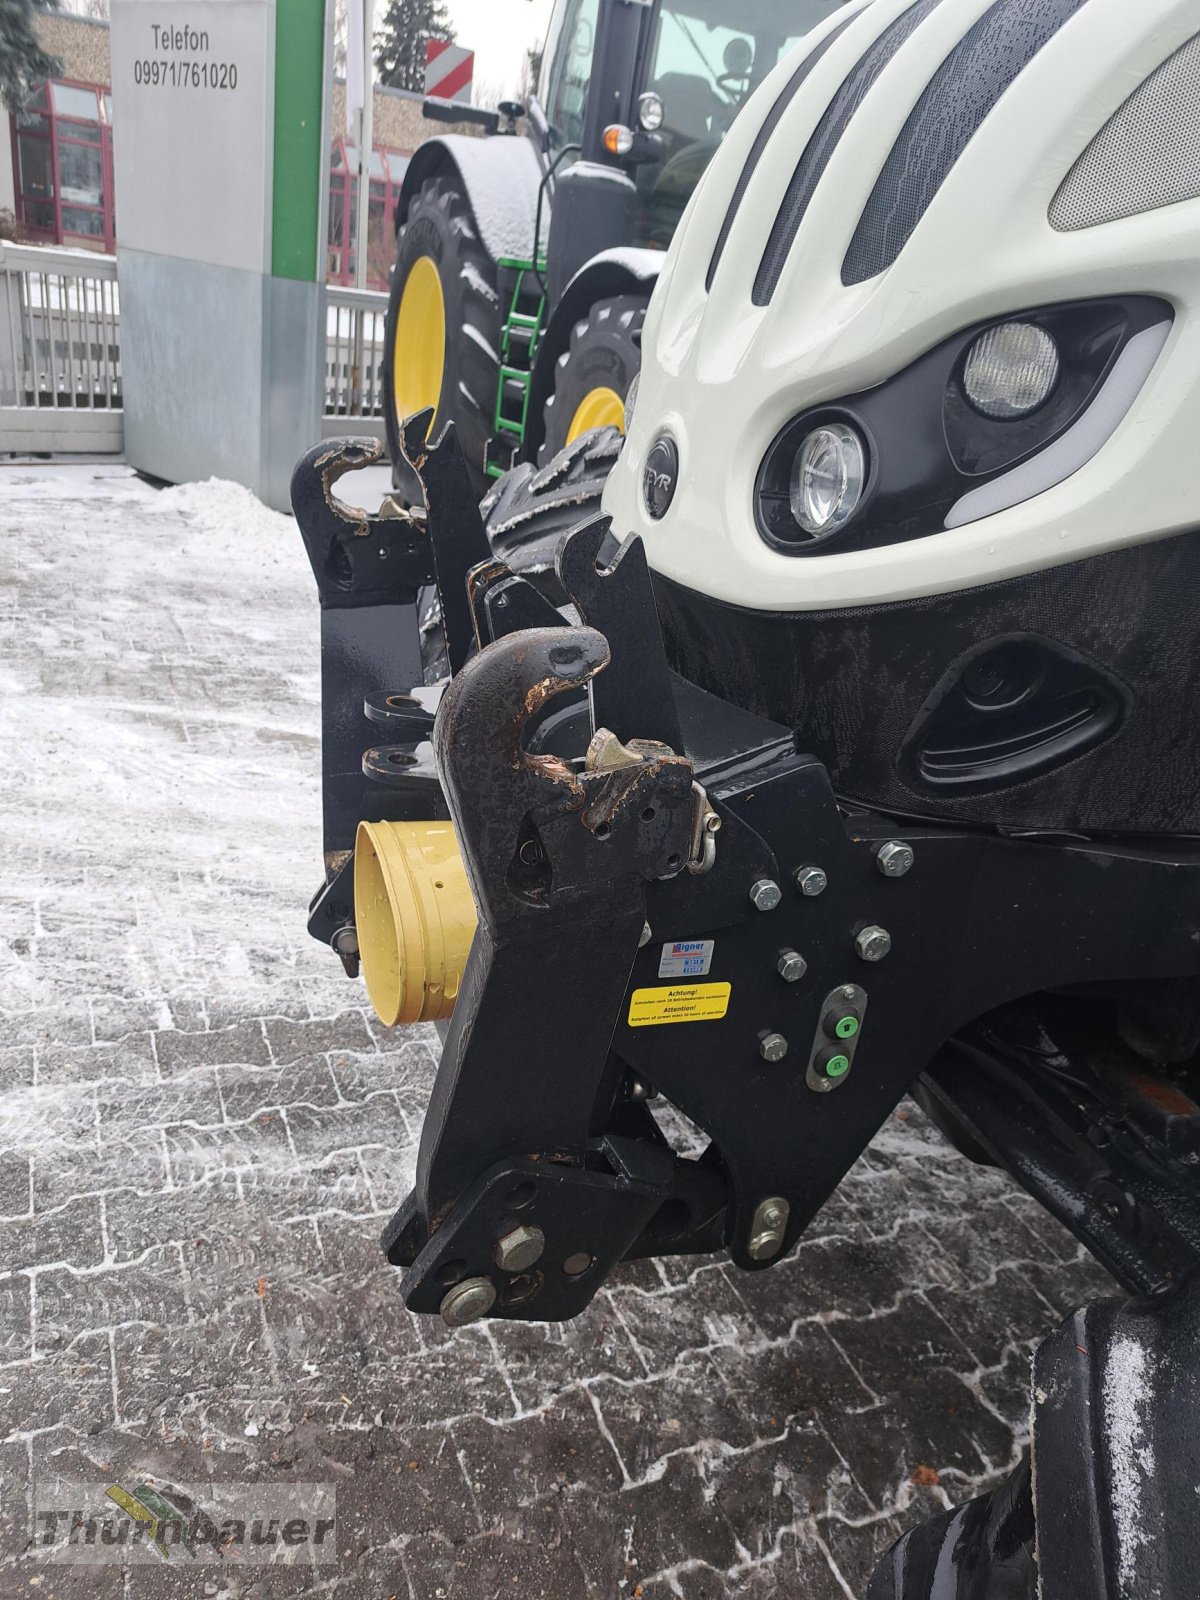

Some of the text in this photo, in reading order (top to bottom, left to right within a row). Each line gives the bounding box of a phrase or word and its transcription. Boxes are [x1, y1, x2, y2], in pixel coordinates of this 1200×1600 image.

[151, 24, 209, 51] Telefon
[134, 60, 238, 90] 09971/761020
[668, 989, 698, 997] Achtung!
[663, 1005, 697, 1013] Attention!
